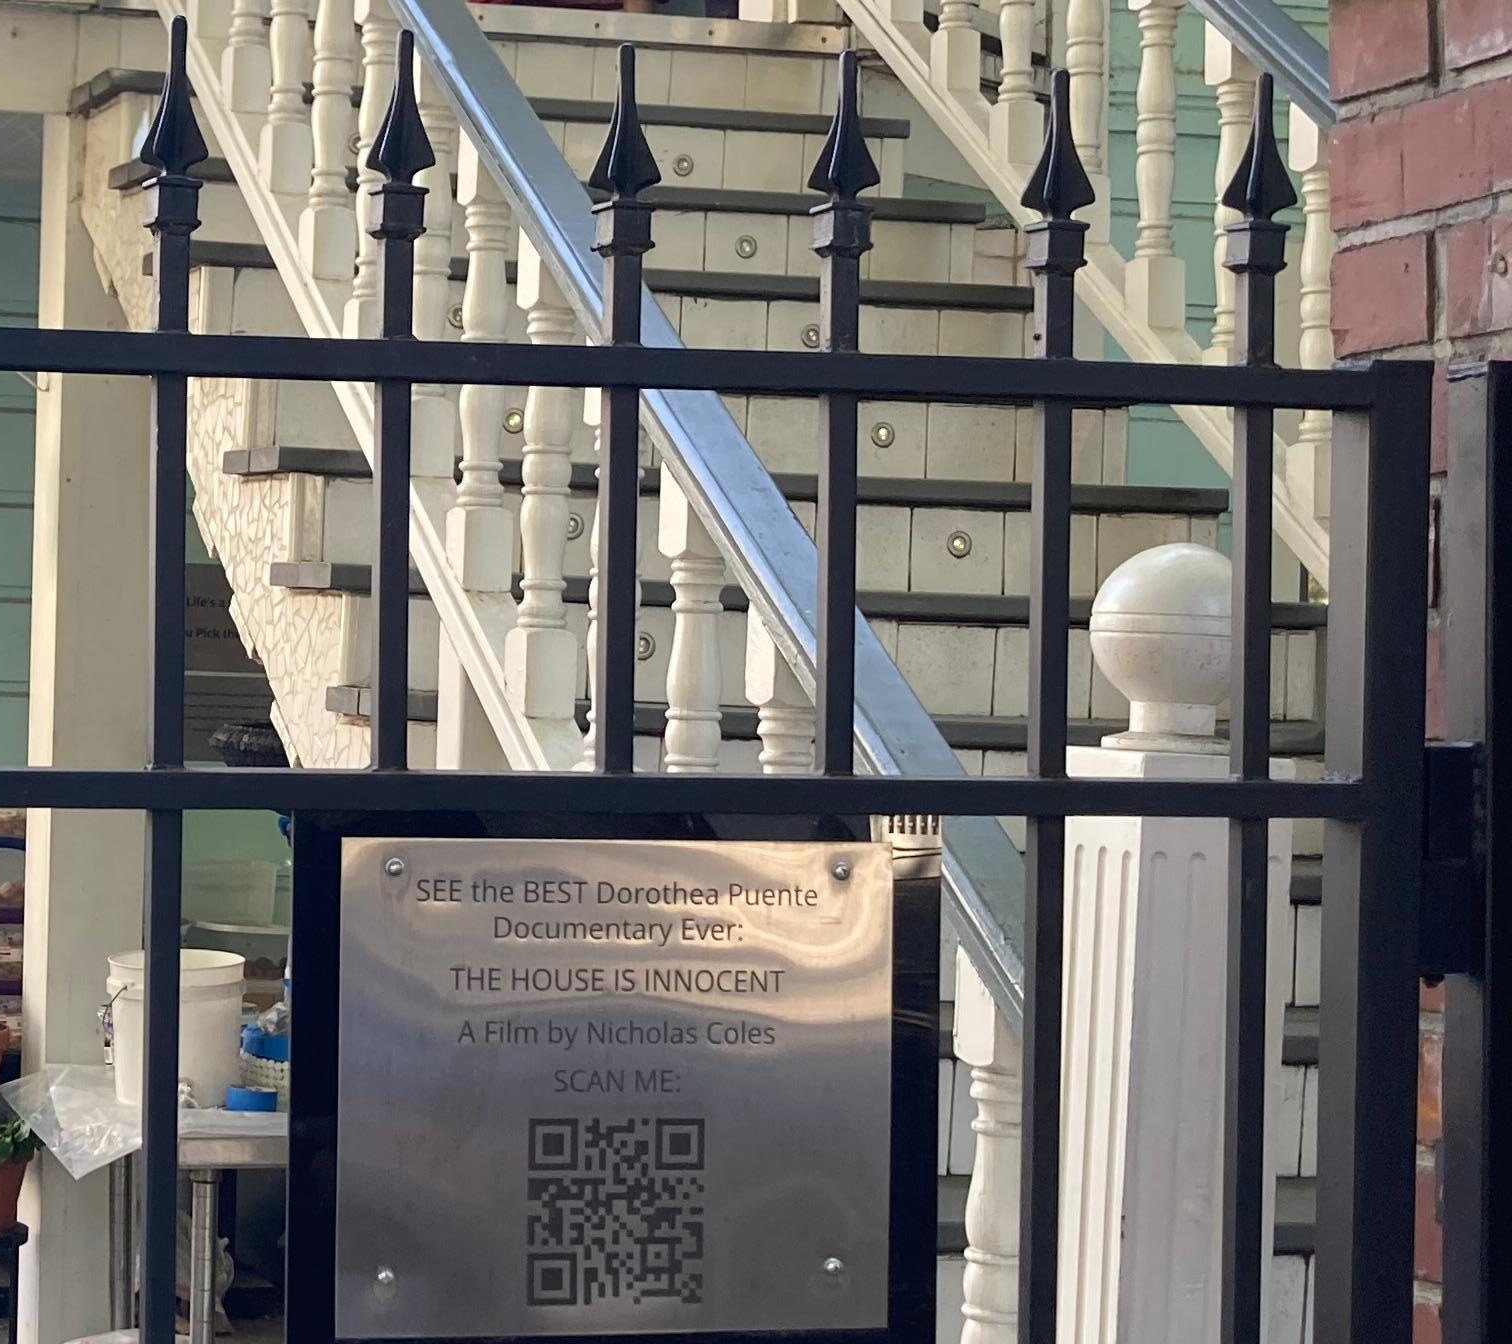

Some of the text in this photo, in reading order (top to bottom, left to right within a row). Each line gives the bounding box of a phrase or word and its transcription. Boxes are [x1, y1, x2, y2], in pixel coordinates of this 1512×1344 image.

[415, 880, 817, 908] SEE the BEST Dorothea Puente
[494, 917, 744, 947] Documentary Ever:
[451, 968, 785, 994] THE HOUSE IS INNOCENT
[458, 1021, 775, 1051] A Film by Nicholas Coles
[554, 1070, 681, 1094] SCAN ME:
